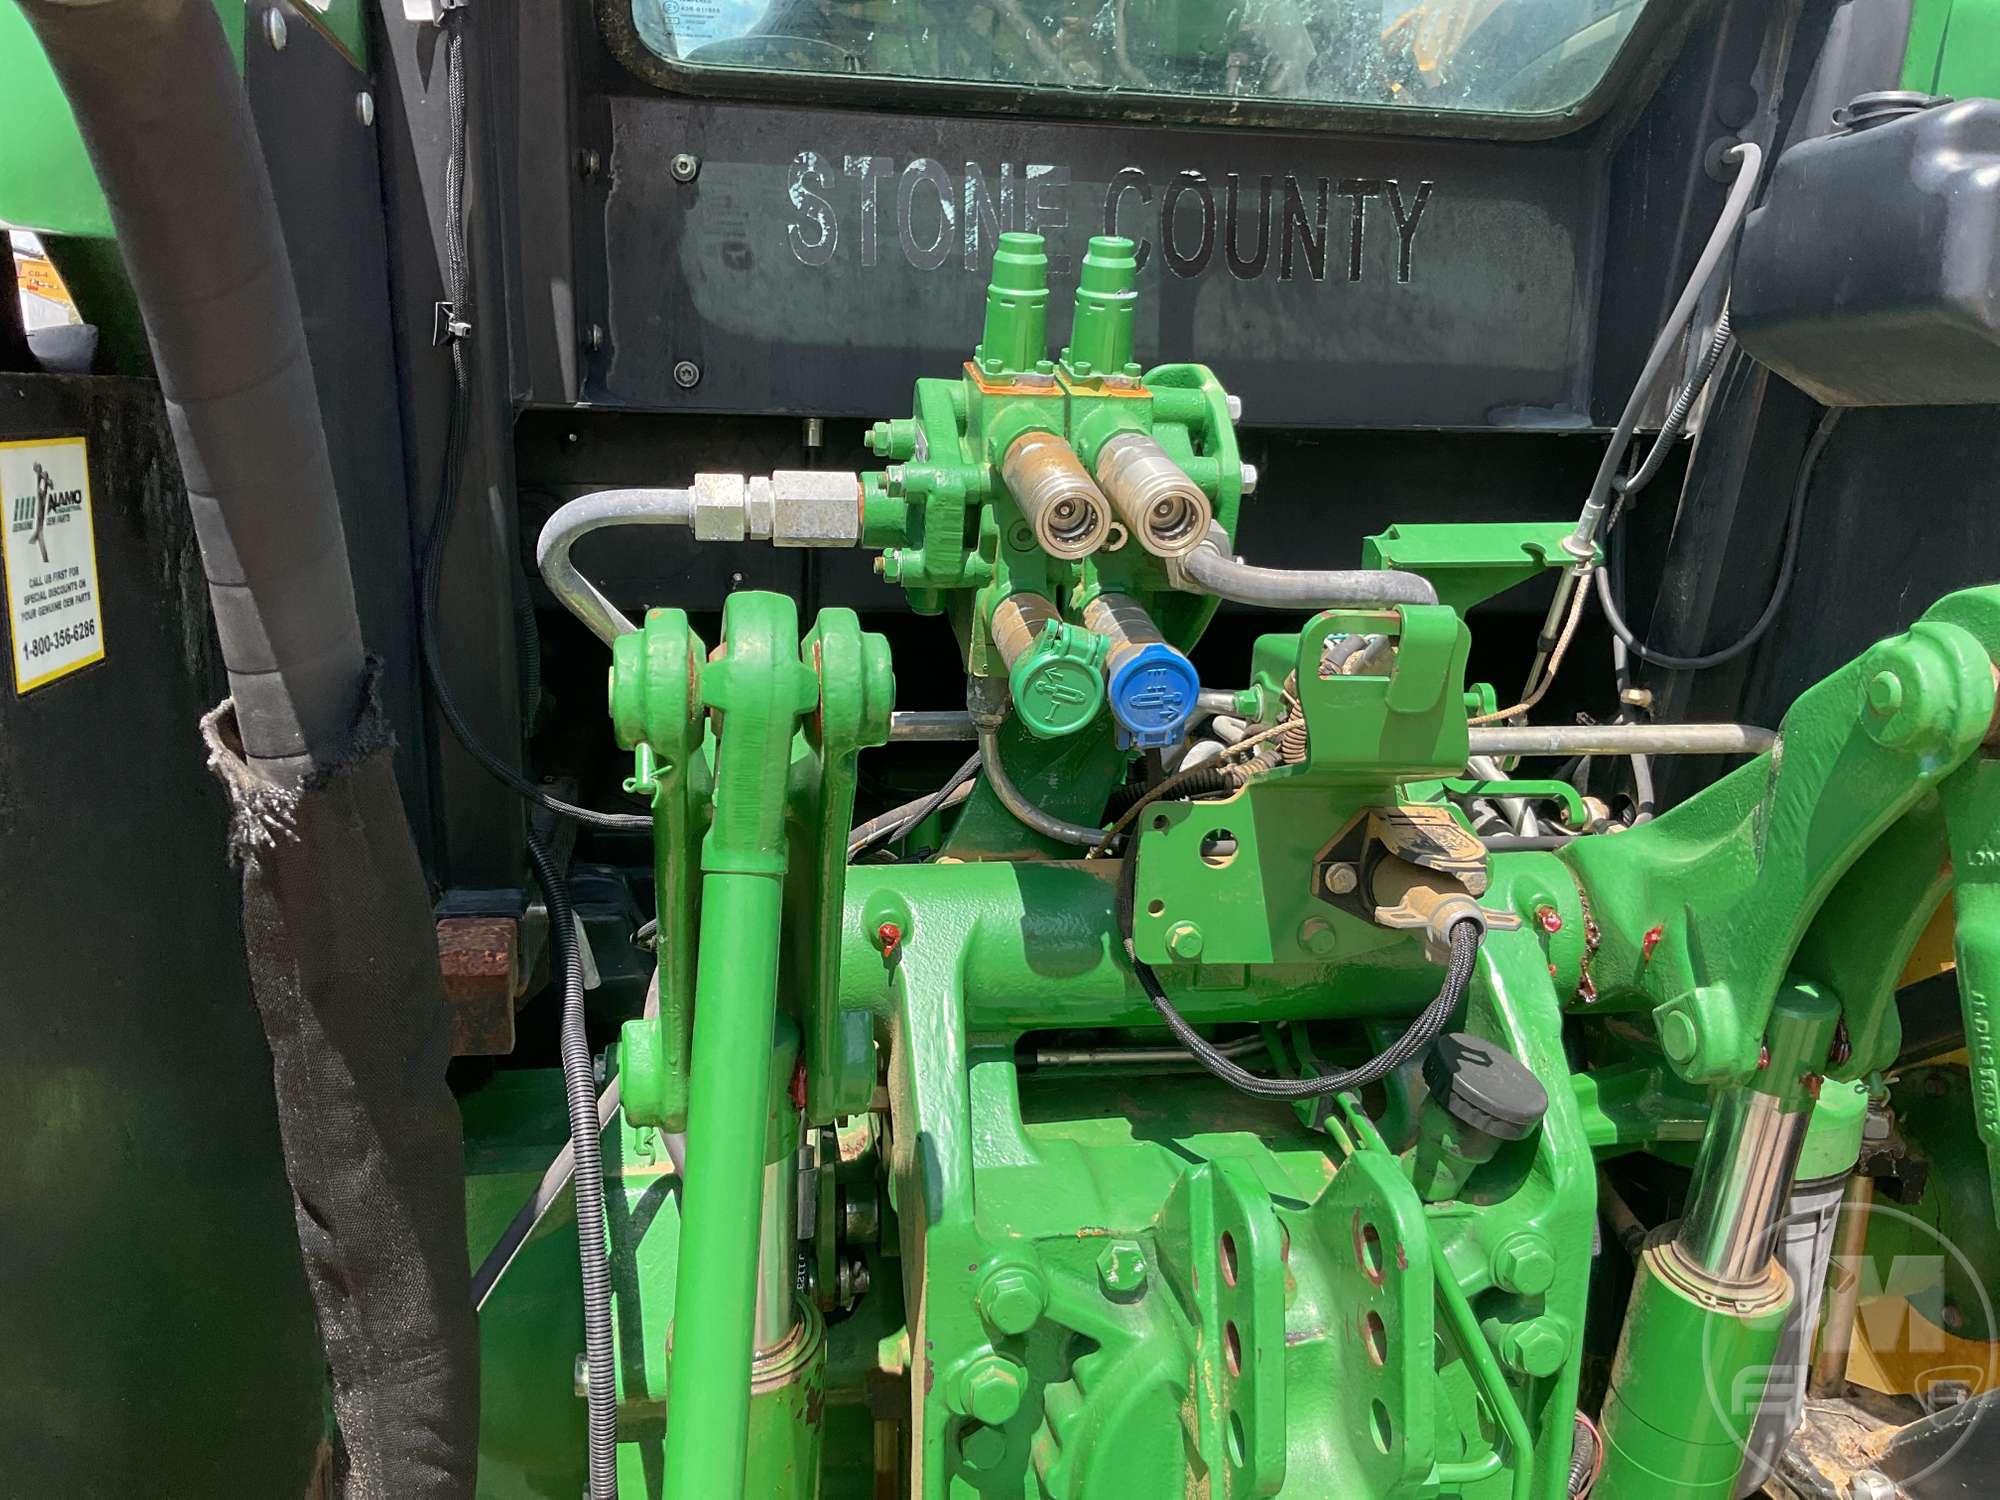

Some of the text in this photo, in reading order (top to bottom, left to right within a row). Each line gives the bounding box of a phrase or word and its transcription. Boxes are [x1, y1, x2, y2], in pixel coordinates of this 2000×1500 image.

[786, 151, 1434, 283] STONE COUNTY
[47, 490, 82, 513] ALAMO
[29, 566, 79, 588] CALL US FIRST FOR
[20, 592, 91, 622] YOUR GENUINE OEM PARTS
[24, 591, 47, 606] SPECIAL
[48, 581, 78, 598] DISCOUNTS
[23, 619, 95, 660] 1-800-356-6286
